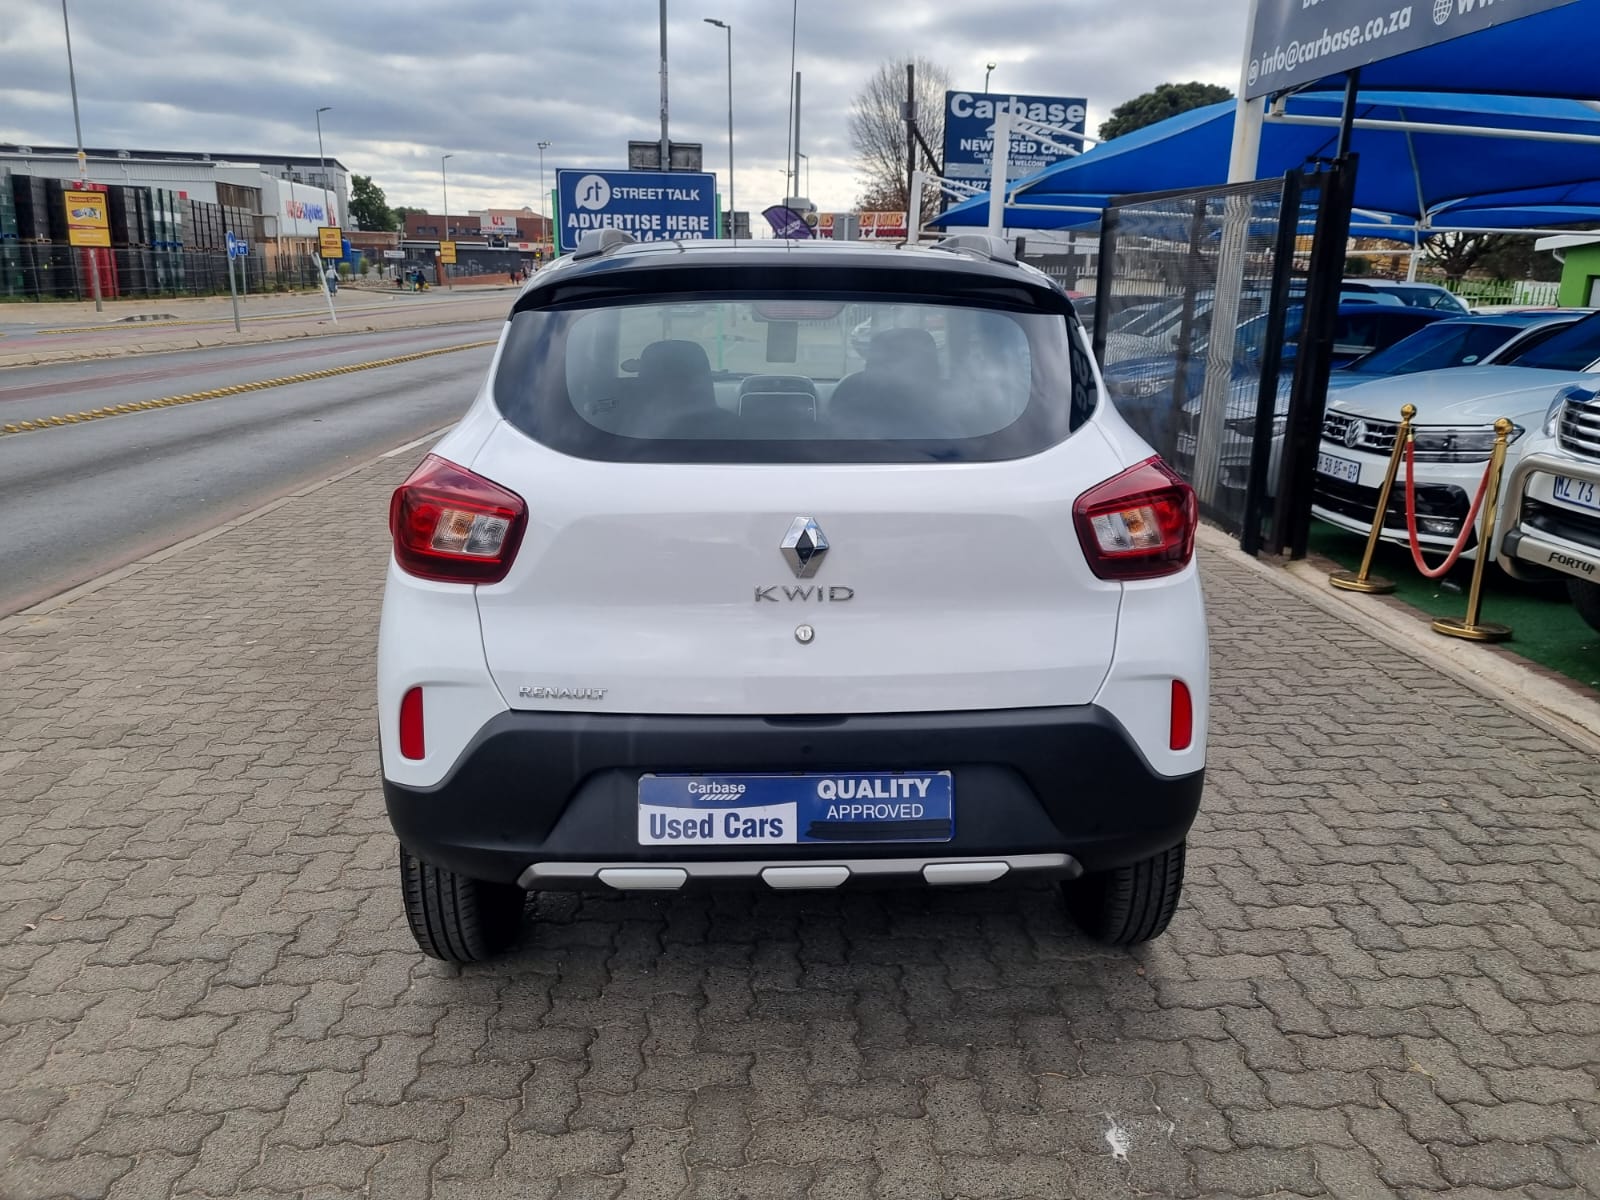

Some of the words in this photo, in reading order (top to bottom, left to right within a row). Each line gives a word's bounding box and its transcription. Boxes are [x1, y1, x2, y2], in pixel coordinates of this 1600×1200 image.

[1260, 6, 1413, 76] info@carbase.co.za
[950, 93, 1085, 122] Carbase
[960, 138, 993, 151] NEW
[612, 187, 664, 200] STREET
[666, 188, 700, 201] TALK
[567, 213, 661, 230] ADVERTISE
[666, 215, 709, 231] HERE
[1347, 464, 1358, 480] GP
[754, 585, 855, 602] KWID
[518, 686, 608, 700] RENAULT
[687, 782, 746, 794] Carbase
[816, 778, 931, 800] QUALITY
[826, 803, 924, 820] APPROVED
[649, 811, 714, 840] Used
[724, 809, 784, 839] Cars
